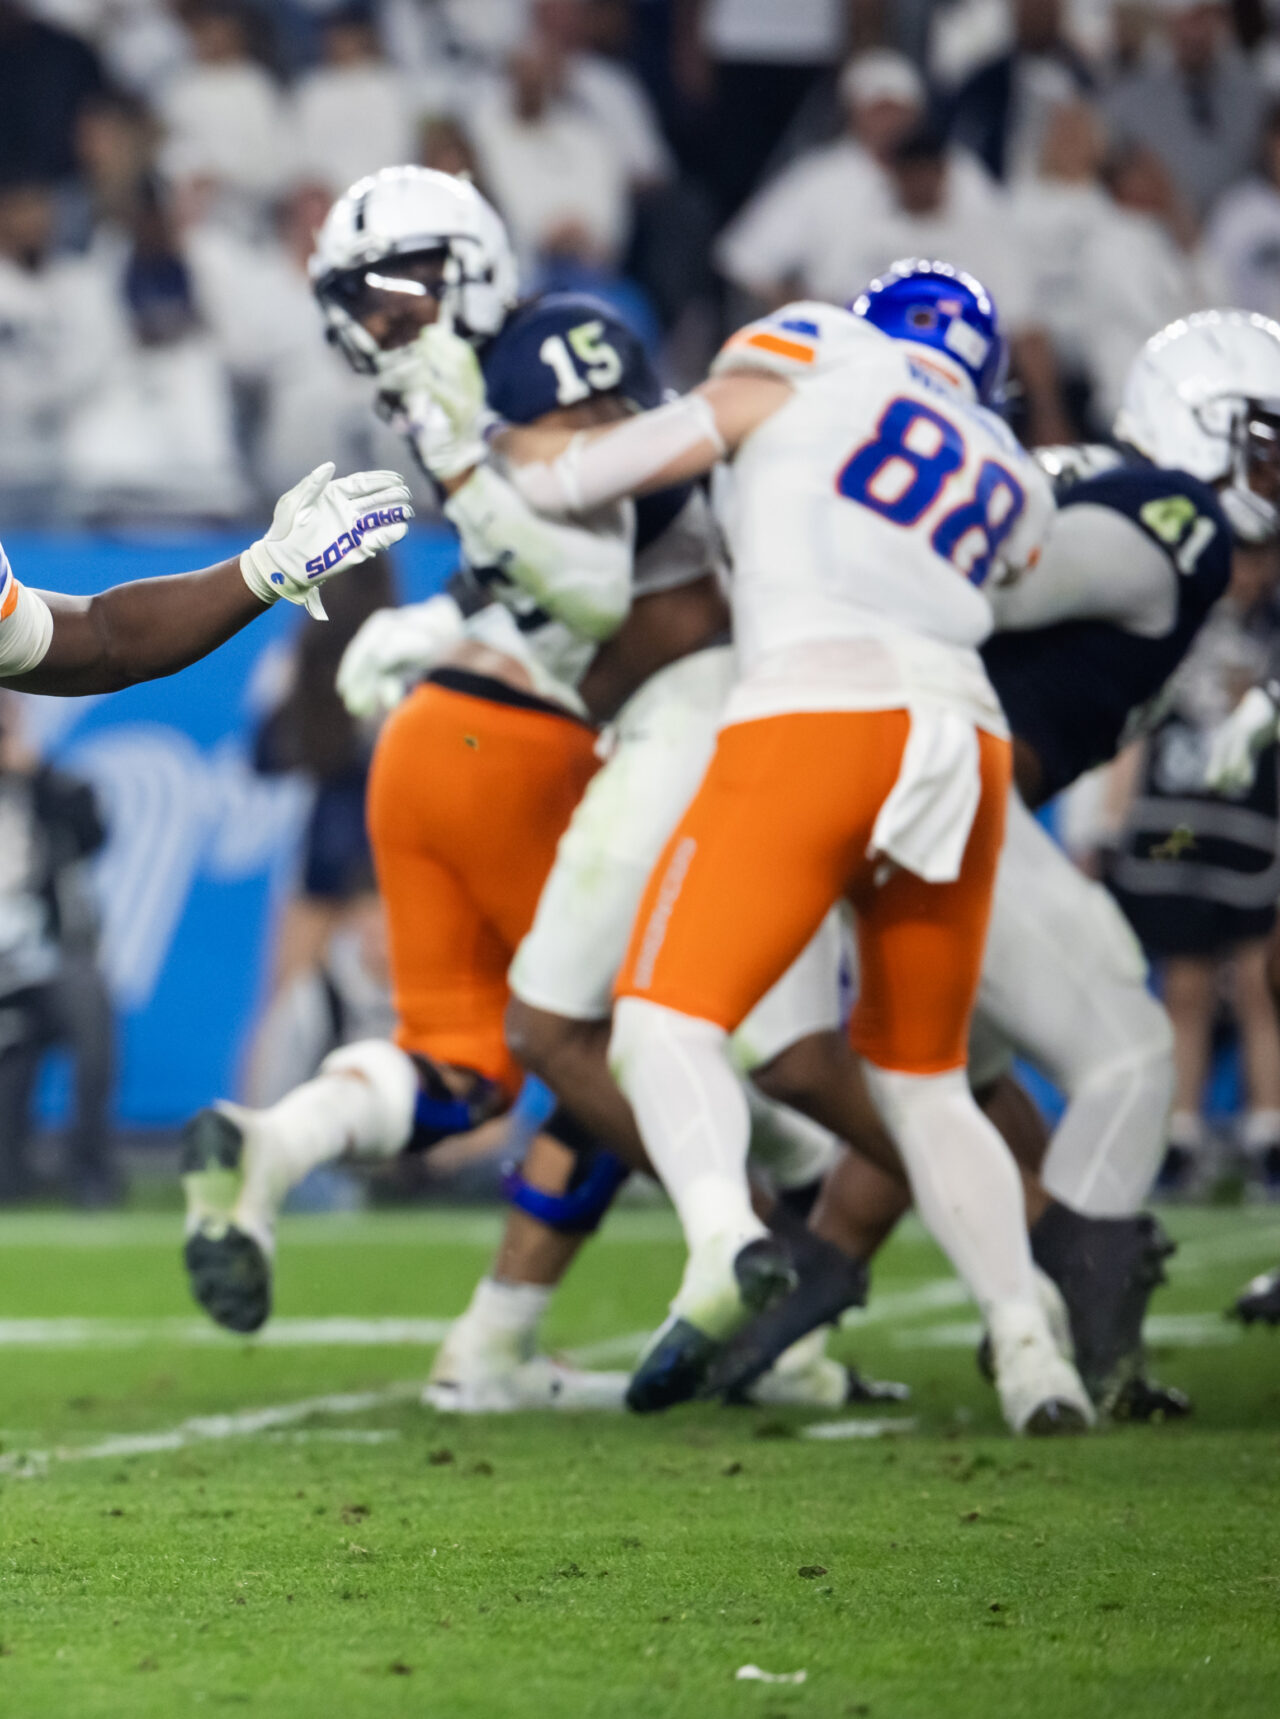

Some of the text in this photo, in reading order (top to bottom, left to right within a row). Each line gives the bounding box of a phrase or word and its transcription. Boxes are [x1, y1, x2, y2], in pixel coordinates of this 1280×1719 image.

[539, 320, 622, 405] 15
[834, 395, 1028, 589] 88
[305, 506, 405, 579] BRONCOS
